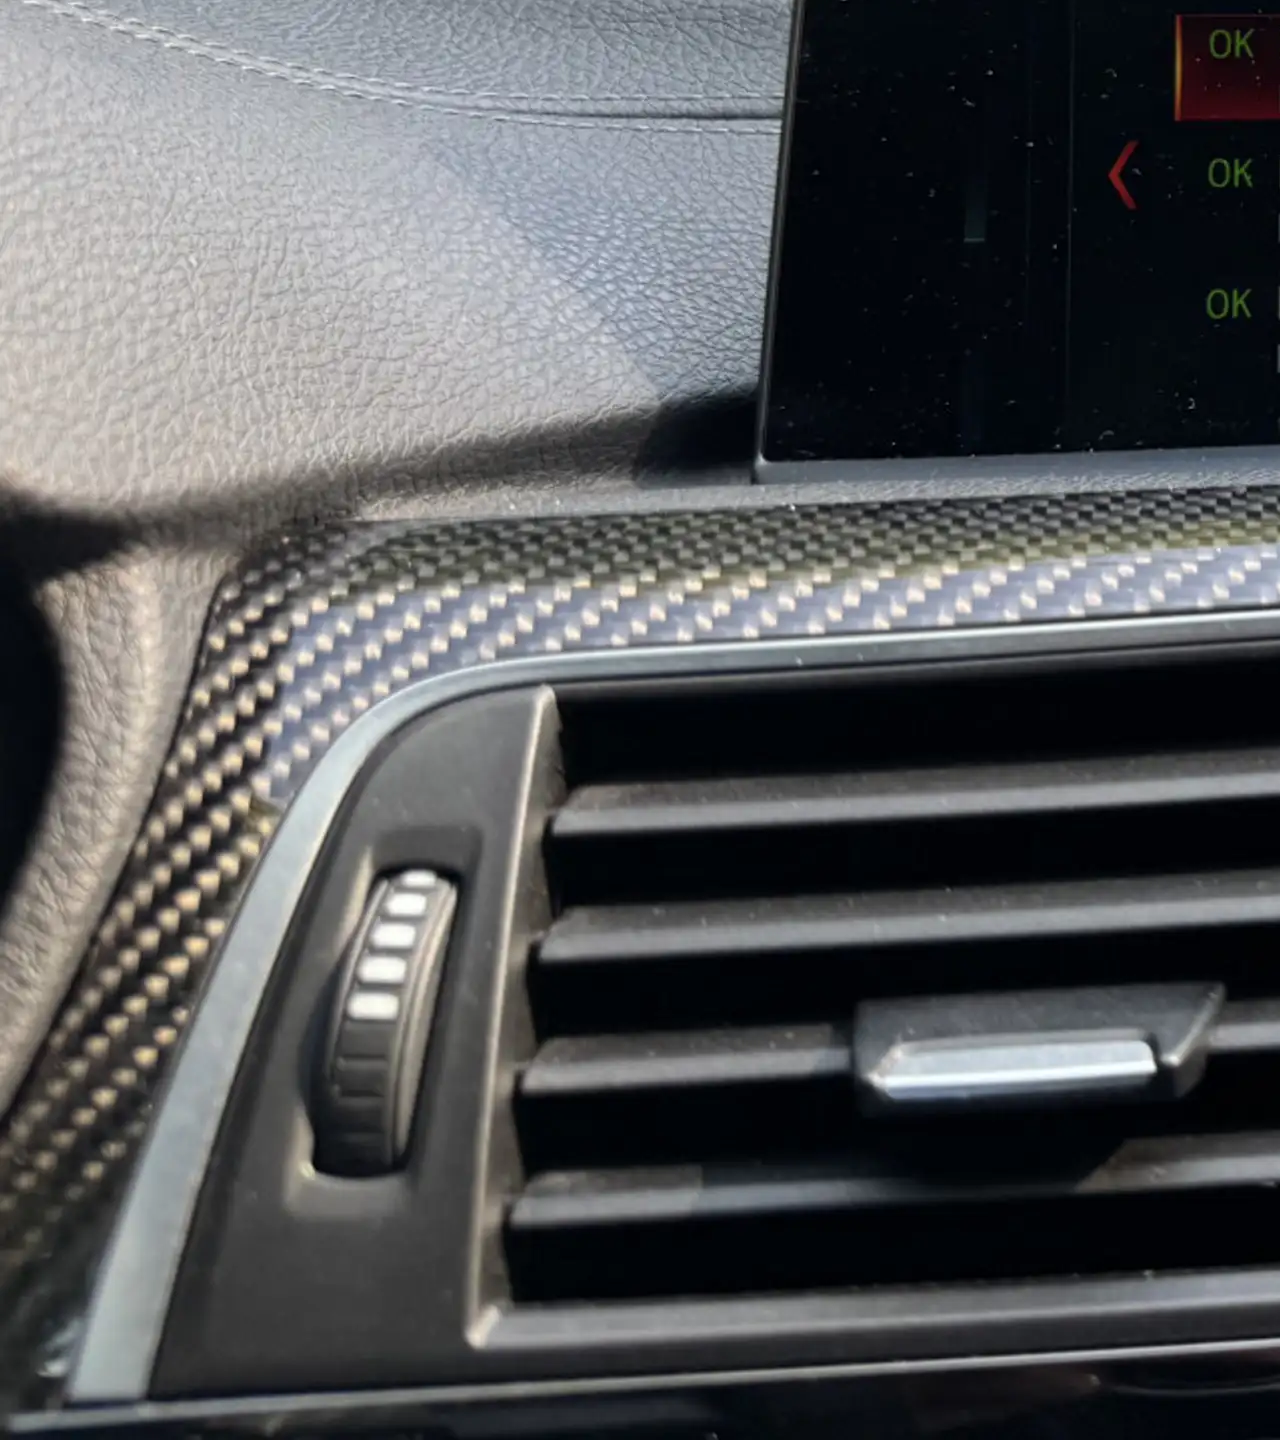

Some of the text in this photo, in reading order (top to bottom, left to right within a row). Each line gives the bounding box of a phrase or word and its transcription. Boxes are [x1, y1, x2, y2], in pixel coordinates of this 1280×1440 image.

[1209, 28, 1254, 59] OK
[1208, 158, 1253, 188] OK
[1206, 288, 1252, 320] OK
